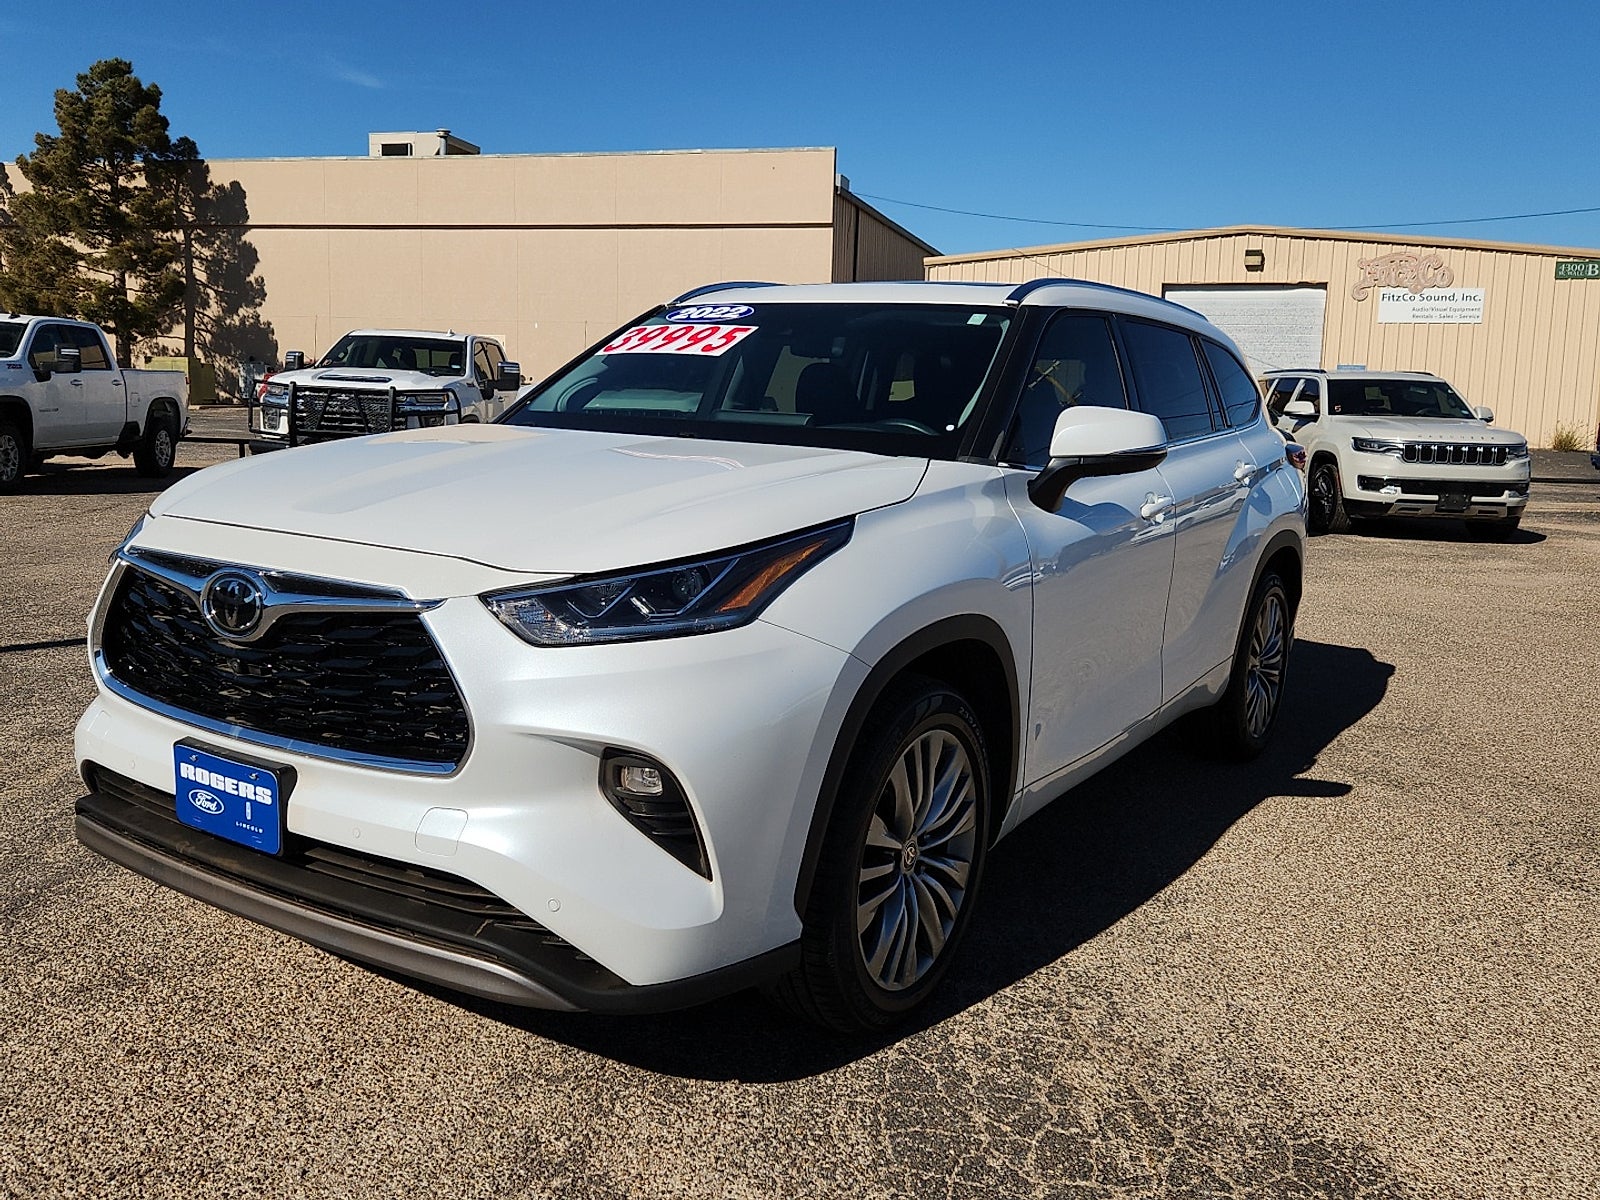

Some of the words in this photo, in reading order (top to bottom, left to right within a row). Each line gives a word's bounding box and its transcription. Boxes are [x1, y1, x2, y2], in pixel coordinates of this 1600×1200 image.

[1558, 263, 1585, 272] 4300
[1588, 263, 1599, 276] B
[1381, 293, 1416, 302] FitzCo
[1419, 293, 1458, 303] Sound,
[1461, 293, 1482, 302] Inc.
[674, 306, 748, 319] 2022
[603, 325, 752, 352] 39995
[180, 762, 272, 805] ROGERS
[195, 792, 217, 812] Ford
